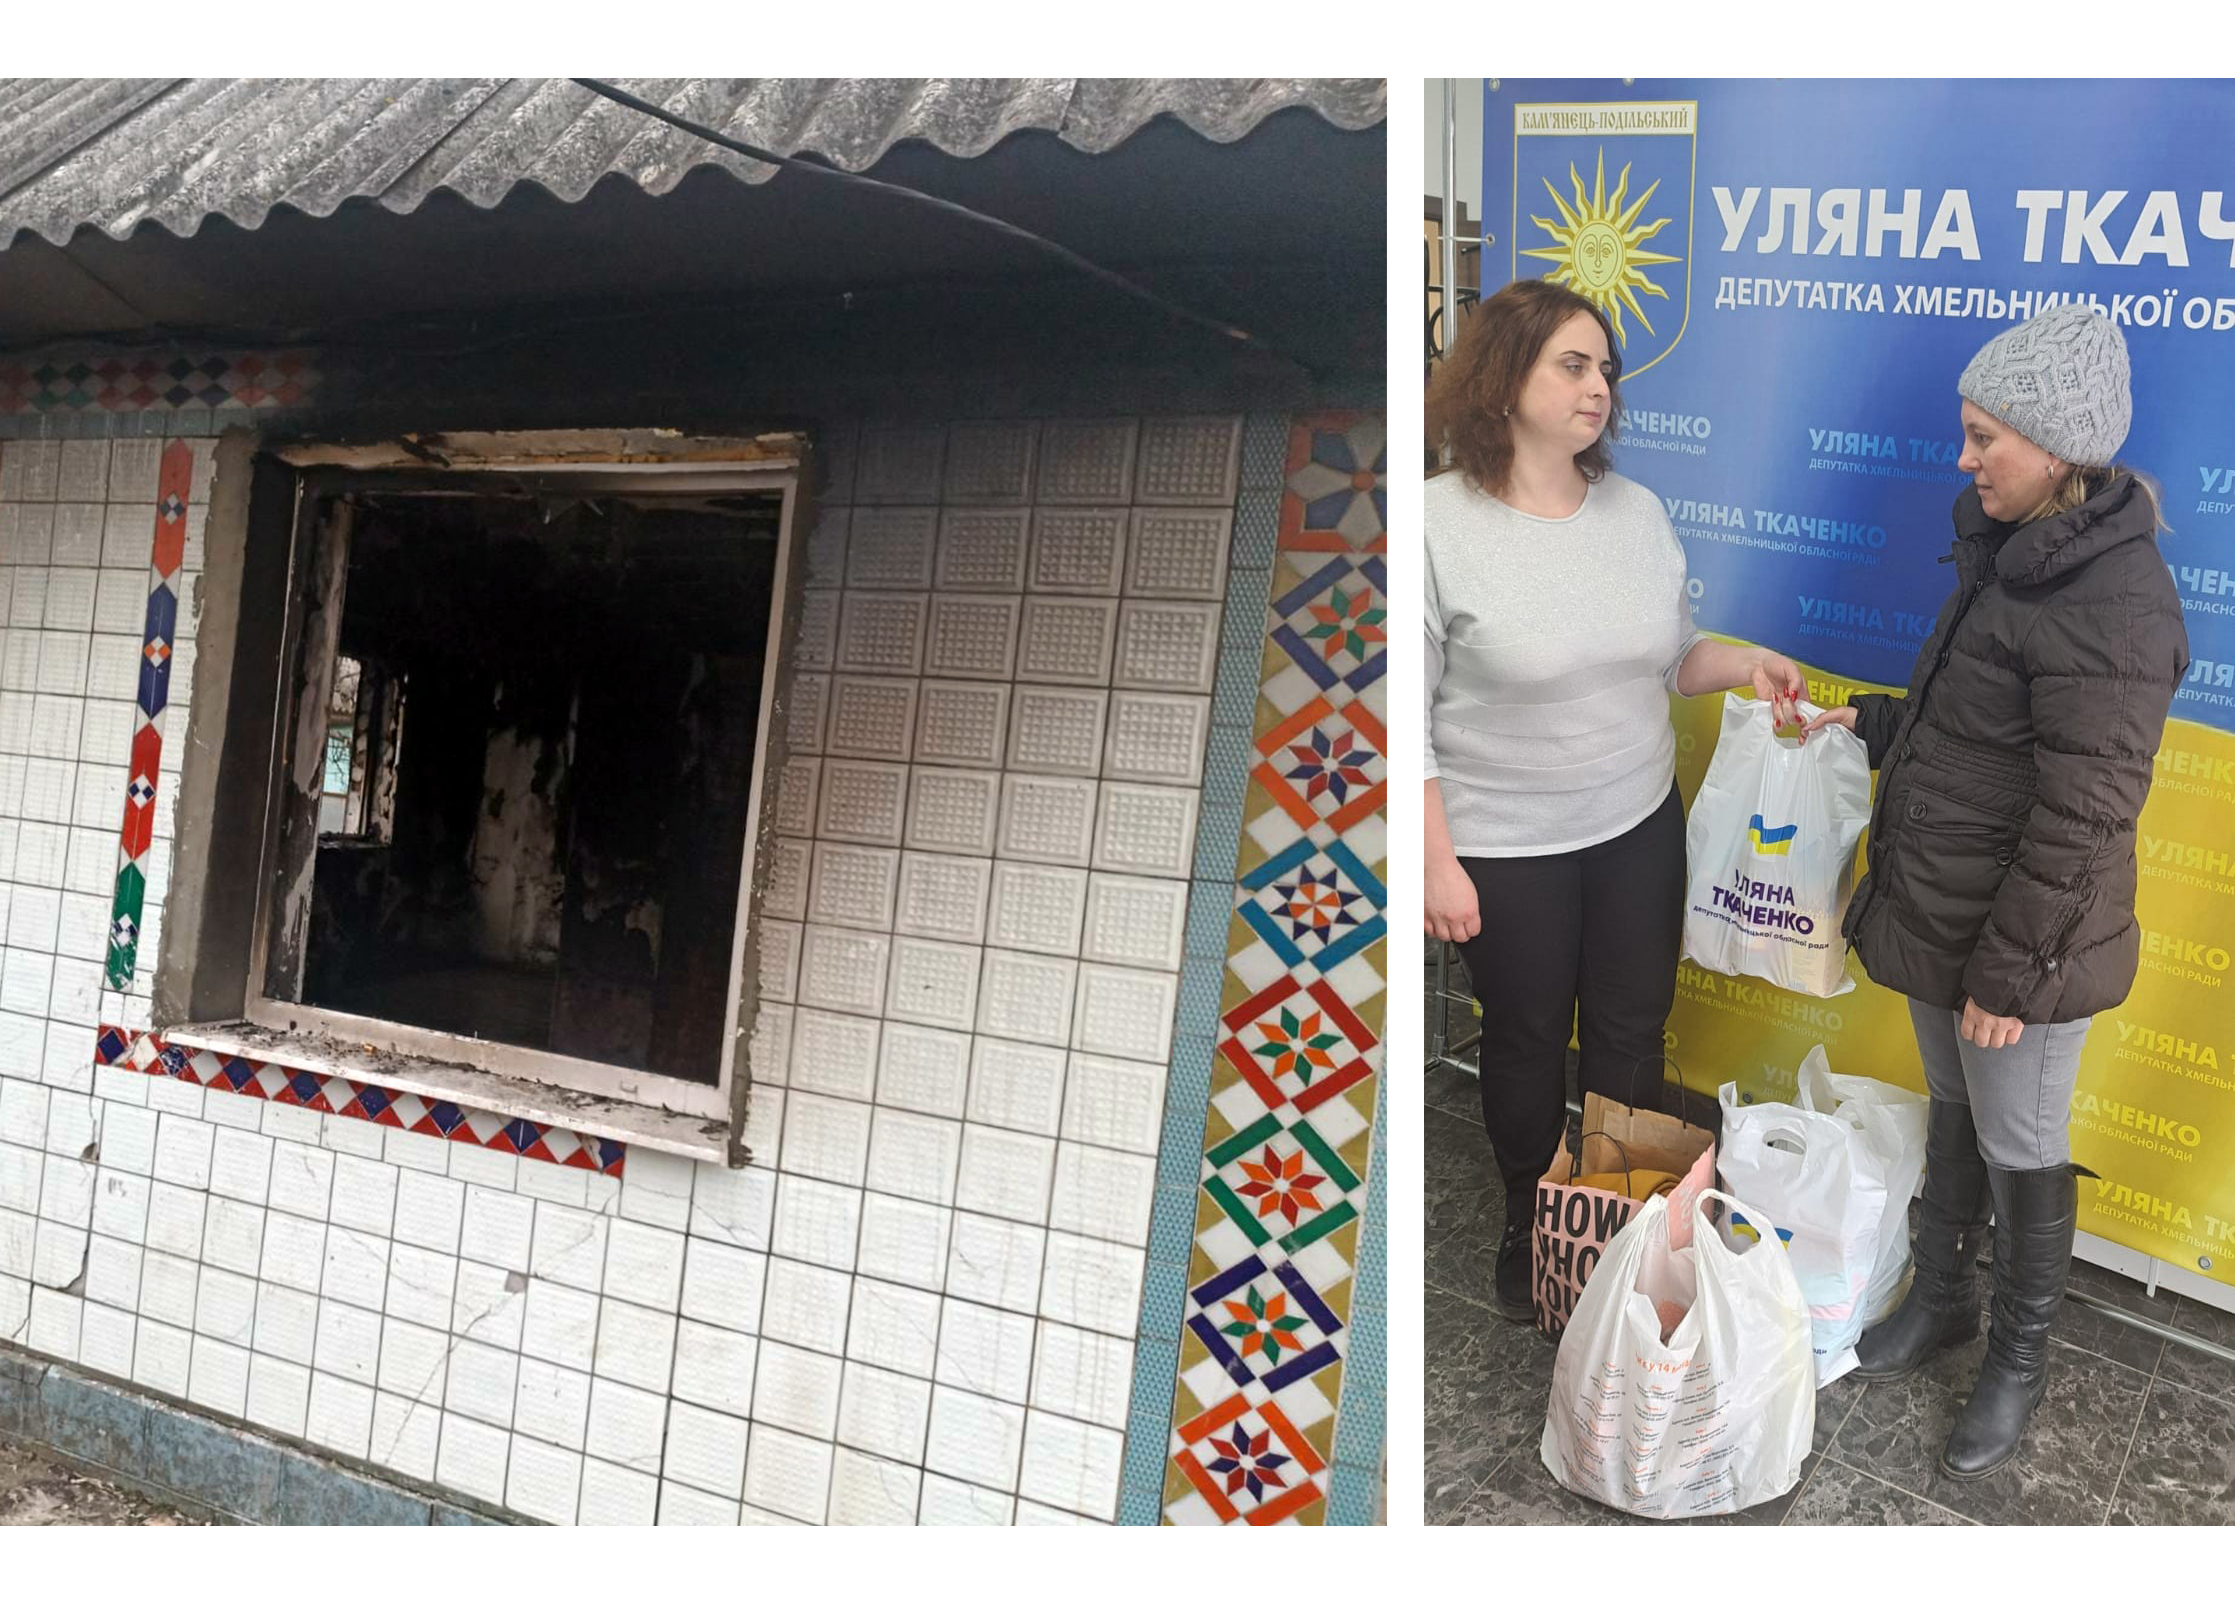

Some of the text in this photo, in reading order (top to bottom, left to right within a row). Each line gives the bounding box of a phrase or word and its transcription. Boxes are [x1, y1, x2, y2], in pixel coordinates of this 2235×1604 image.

[1711, 186, 1981, 261] УЛЯНА
[1715, 276, 1885, 313] ДЕПУТАТКА
[2182, 297, 2235, 331] ОБ
[1632, 437, 1680, 452] ОБЛАСНОЇ
[1681, 443, 1706, 456] РАДИ
[1808, 428, 1898, 460] УЛЯНА
[1809, 458, 1868, 474] ДЕПУТАТКА
[1665, 497, 1887, 549] УЛЯНА ТКАЧЕНКО
[1673, 526, 1720, 542] ЕПУТАТКА
[1721, 533, 1798, 553] ХМЕЛЬНИЦЬКОЇ
[1798, 595, 1884, 630] УЛЯНА
[1799, 623, 1856, 640] ДЕПУТАТКА
[2189, 658, 2235, 688] ЛЯ
[1808, 679, 1868, 706] ЕНК
[2174, 687, 2235, 708] ЕПУТАТК
[2216, 789, 2235, 805] РА
[2141, 864, 2212, 891] ДЕПУТАТКА
[1712, 885, 1815, 935] ТКАЧЕНКО
[1808, 942, 1829, 950] ради
[2187, 969, 2222, 989] РАДИ
[1724, 979, 1843, 1032] ТКАЧЕНКО
[2116, 1019, 2219, 1071] УЛЯНА
[2115, 1046, 2183, 1075] ДЕПУТАТКА
[2098, 1124, 2159, 1152] ОБЛАСНОЇ
[2160, 1144, 2193, 1164] РАДИ
[1538, 1187, 1631, 1243] HOW
[2093, 1202, 2158, 1233] ДЕПУТАТКА
[2094, 1178, 2193, 1230] УЛЯНА
